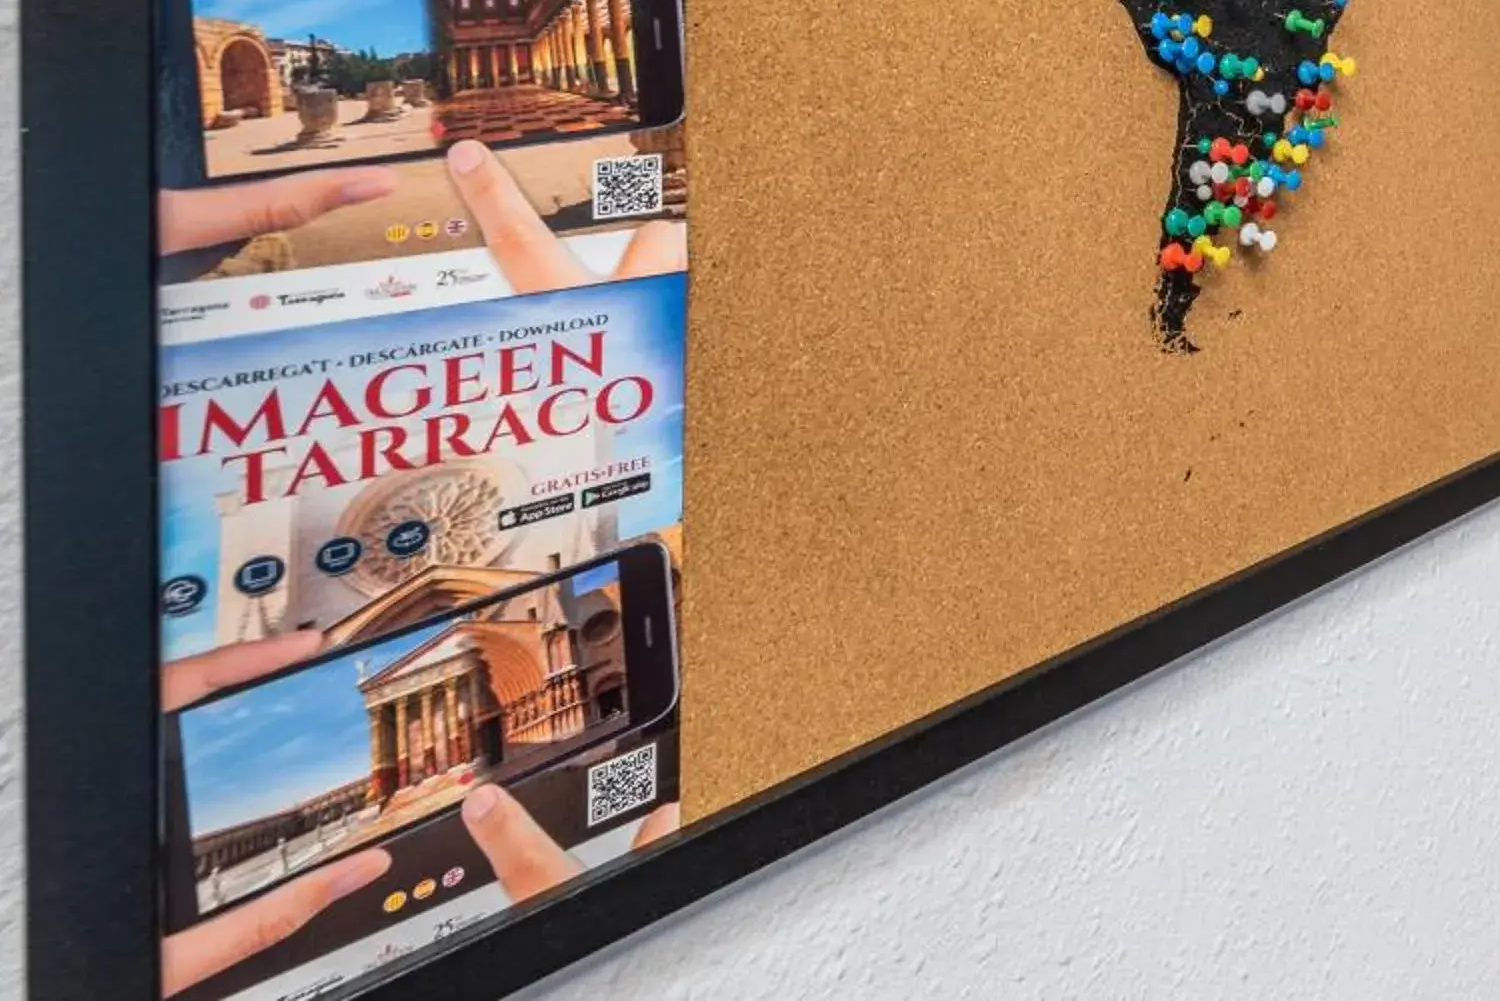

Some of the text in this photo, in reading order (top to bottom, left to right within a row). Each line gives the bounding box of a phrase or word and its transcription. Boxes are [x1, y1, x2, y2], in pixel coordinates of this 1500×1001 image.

[436, 270, 457, 287] 25
[349, 334, 483, 368] DESCÁRGATE
[499, 314, 609, 343] DOWNLOAD
[159, 330, 608, 462] IMAGEEN
[221, 376, 654, 505] TARRACO
[520, 507, 545, 523] App
[545, 502, 573, 516] Store
